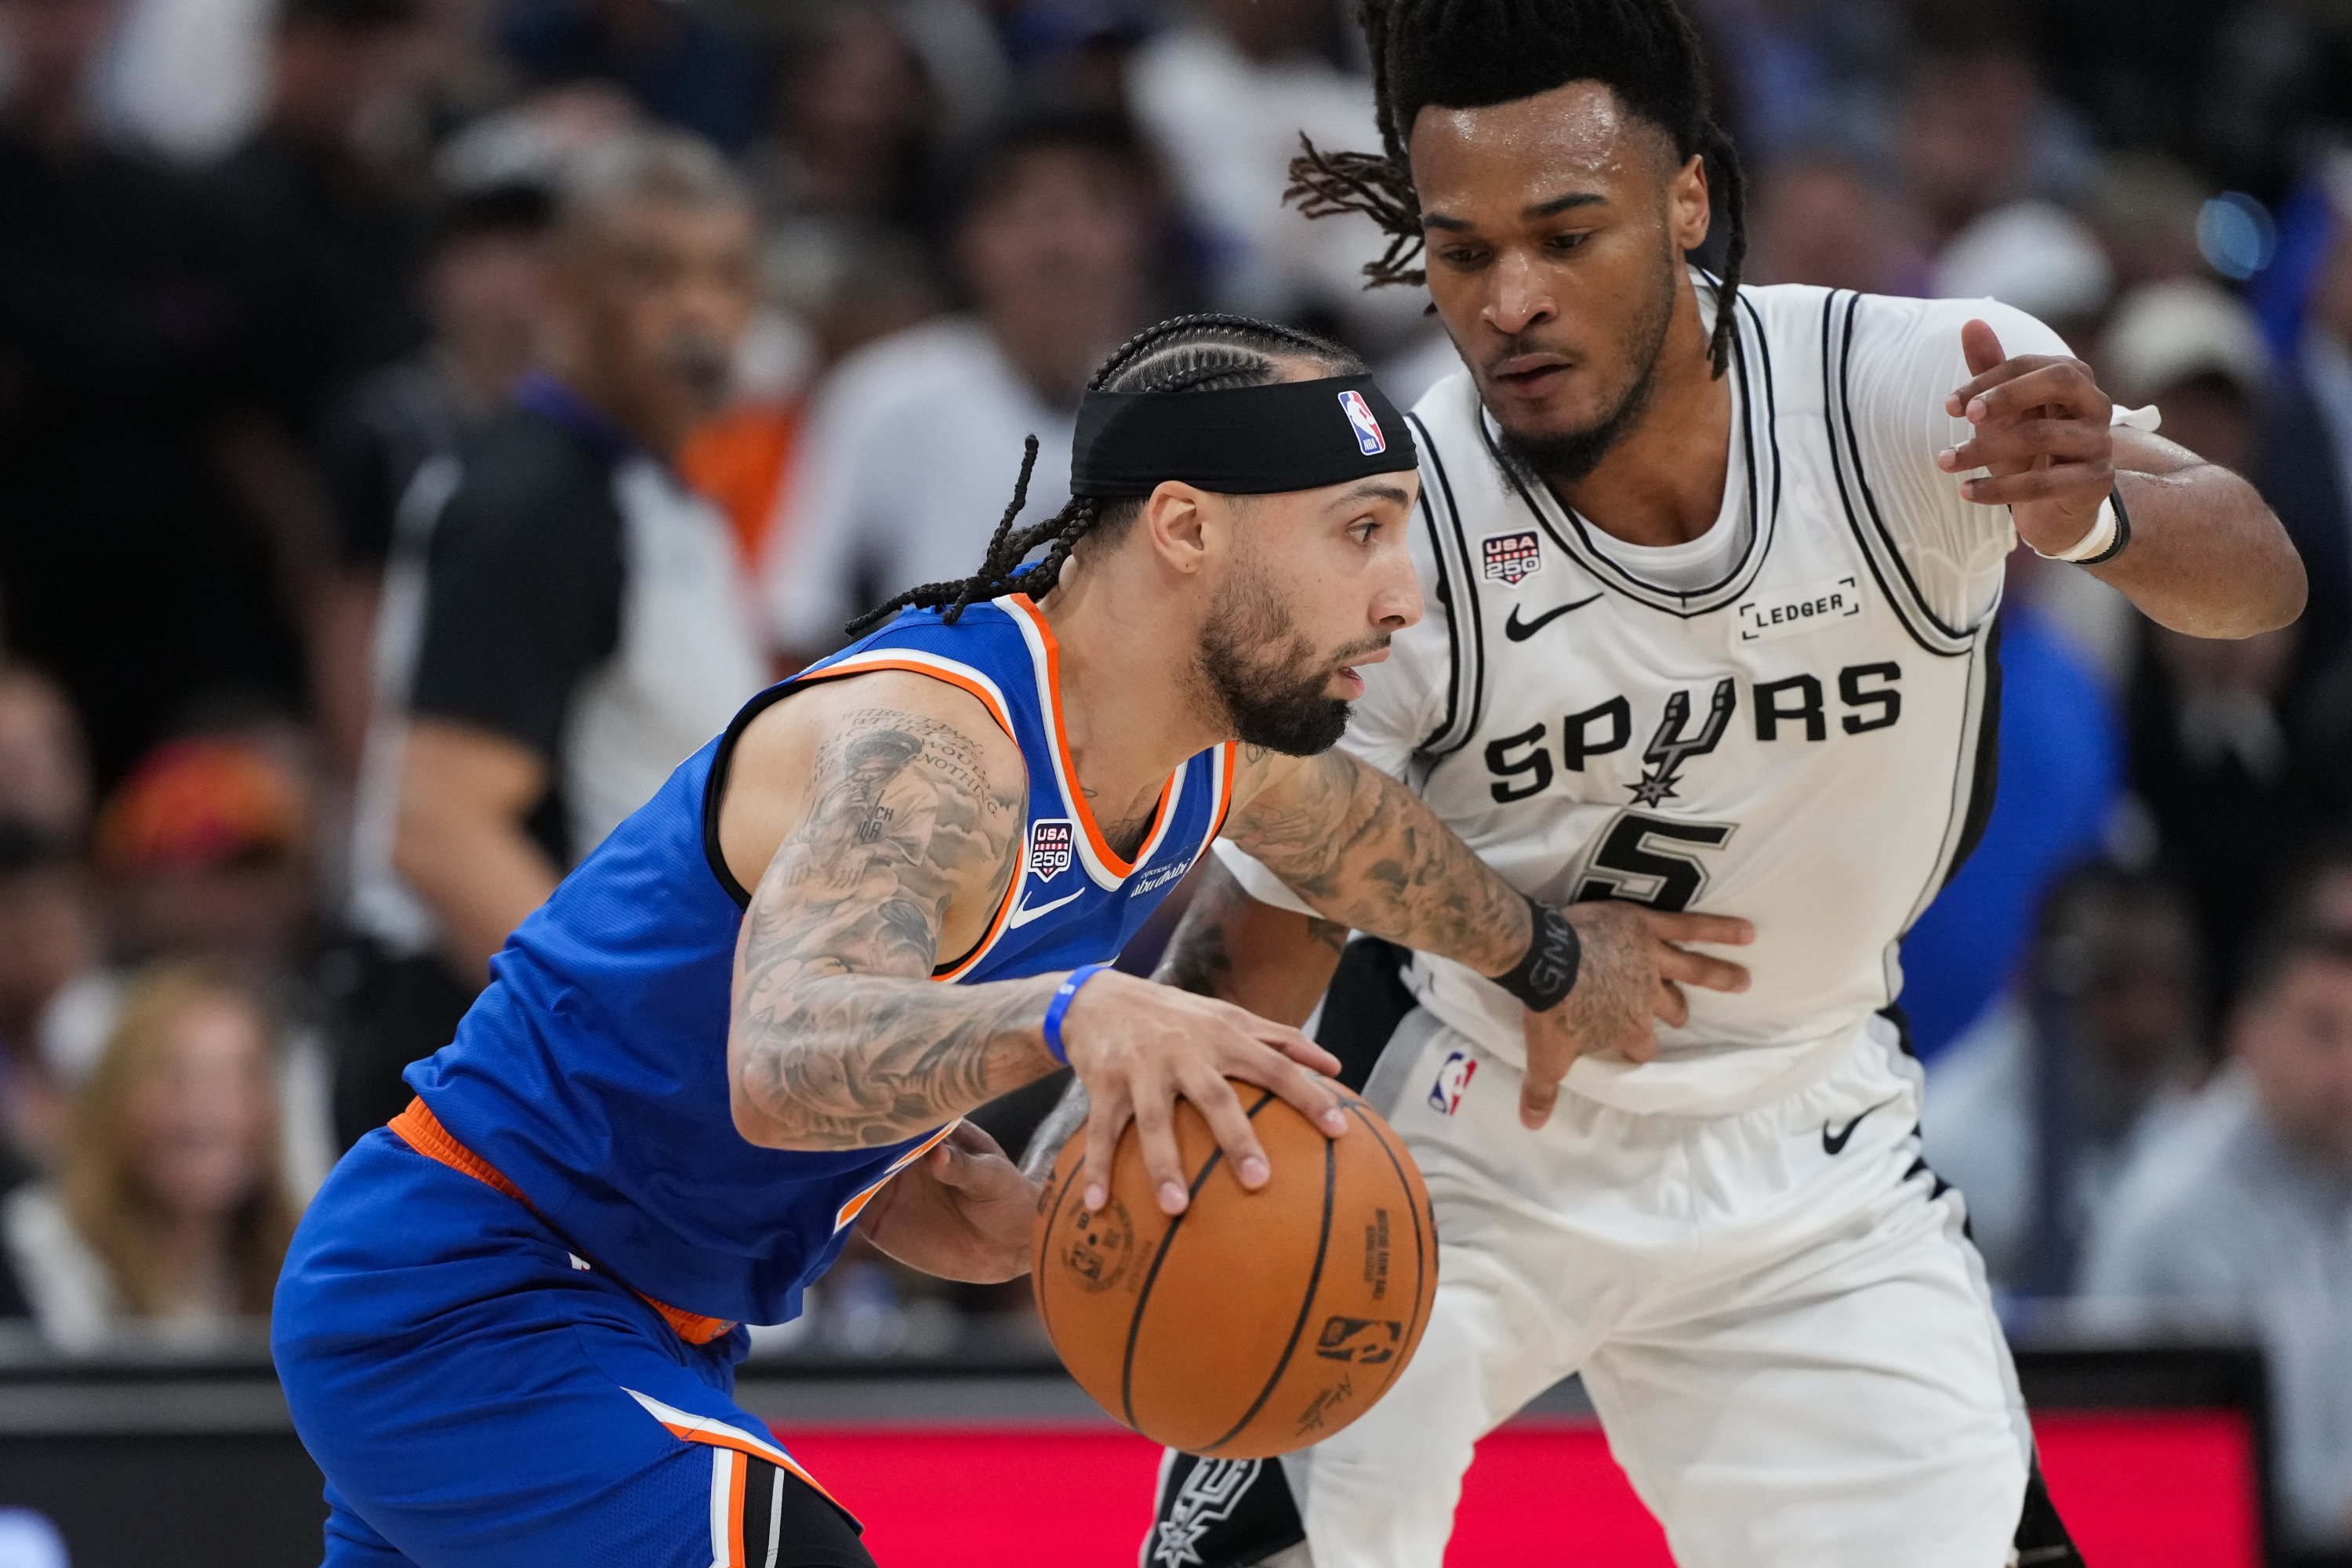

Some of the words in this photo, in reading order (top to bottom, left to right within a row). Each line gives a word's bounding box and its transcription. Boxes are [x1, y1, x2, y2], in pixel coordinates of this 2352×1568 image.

[1363, 437, 1377, 451] NBA
[1486, 535, 1536, 554] USA
[1486, 556, 1540, 578] 250
[1755, 593, 1843, 628] LEDGER
[1484, 661, 1902, 808] SPURS
[921, 738, 991, 790] WOULD
[916, 753, 998, 818] NOTHING.
[1036, 827, 1069, 841] USA
[1032, 851, 1068, 867] 250
[1570, 808, 1740, 912] 5
[1131, 879, 1157, 898] abu
[1154, 857, 1191, 888] dhabi
